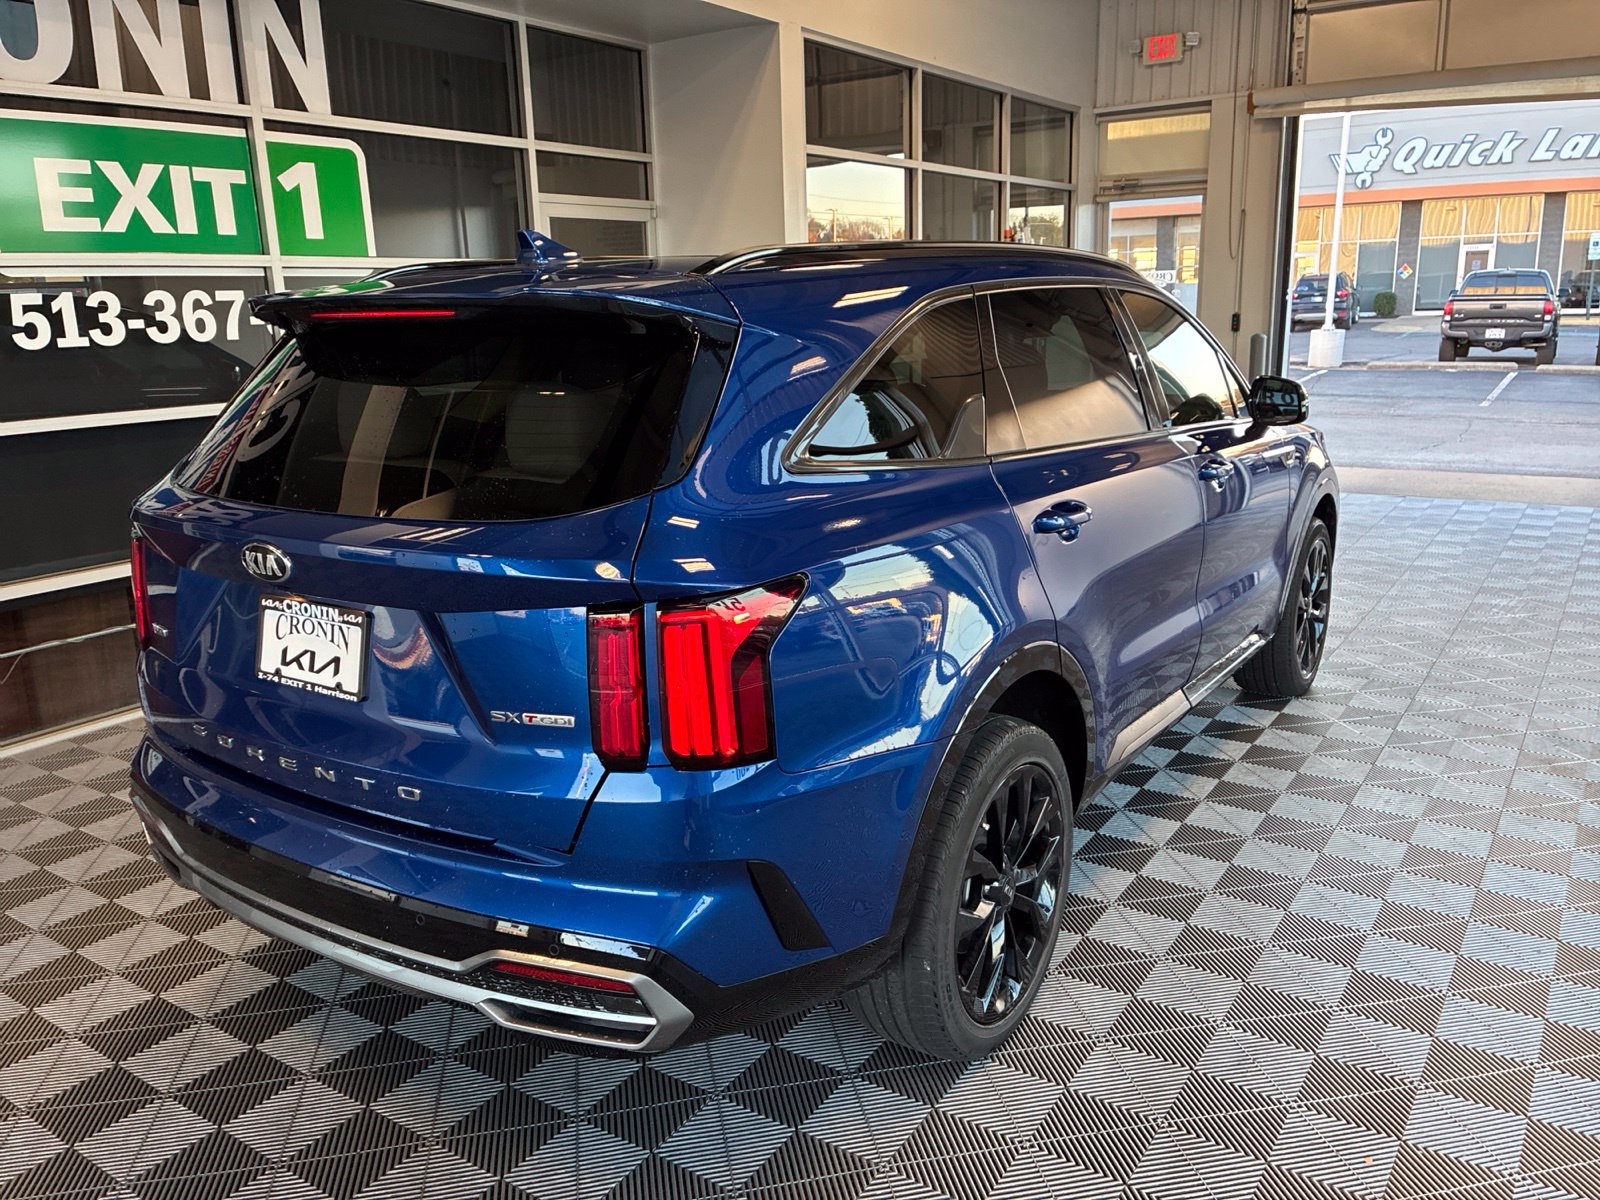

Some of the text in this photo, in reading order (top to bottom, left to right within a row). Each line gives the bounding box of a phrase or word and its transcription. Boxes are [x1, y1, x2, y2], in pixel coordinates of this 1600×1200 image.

[1149, 33, 1178, 59] EXIT
[1392, 130, 1528, 175] Quick
[33, 157, 324, 240] EXIT 1
[9, 289, 285, 350] 513-367-
[244, 550, 283, 577] KIA
[282, 599, 339, 622] CRONIN
[275, 613, 351, 655] CRONIN
[280, 645, 341, 678] KIA
[257, 671, 358, 702] I-74 EXIT 1 Harrison
[490, 710, 520, 724] SX
[192, 722, 422, 801] SORENTO
